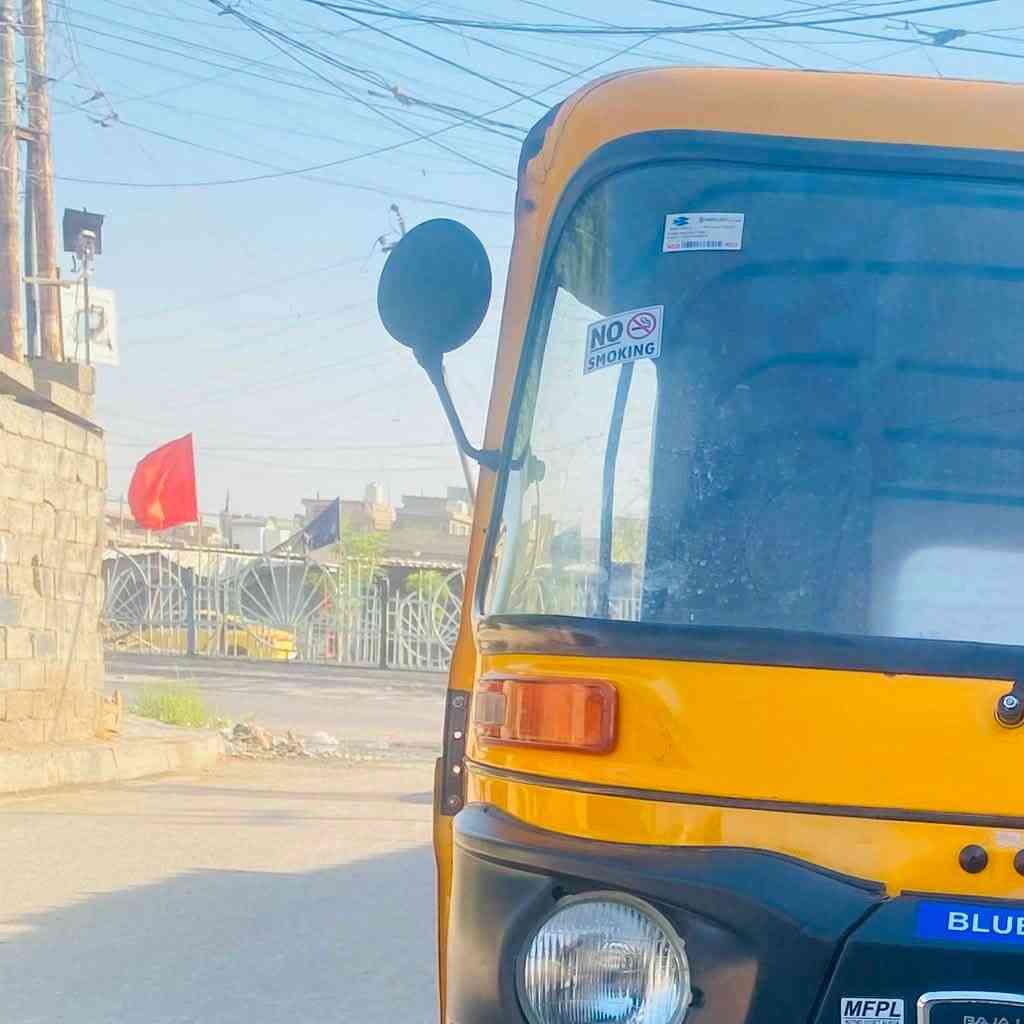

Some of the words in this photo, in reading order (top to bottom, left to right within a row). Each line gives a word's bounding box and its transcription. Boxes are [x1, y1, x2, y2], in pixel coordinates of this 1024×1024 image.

[591, 320, 623, 349] NO
[588, 342, 655, 370] SMOKING
[844, 1000, 901, 1017] MFPL
